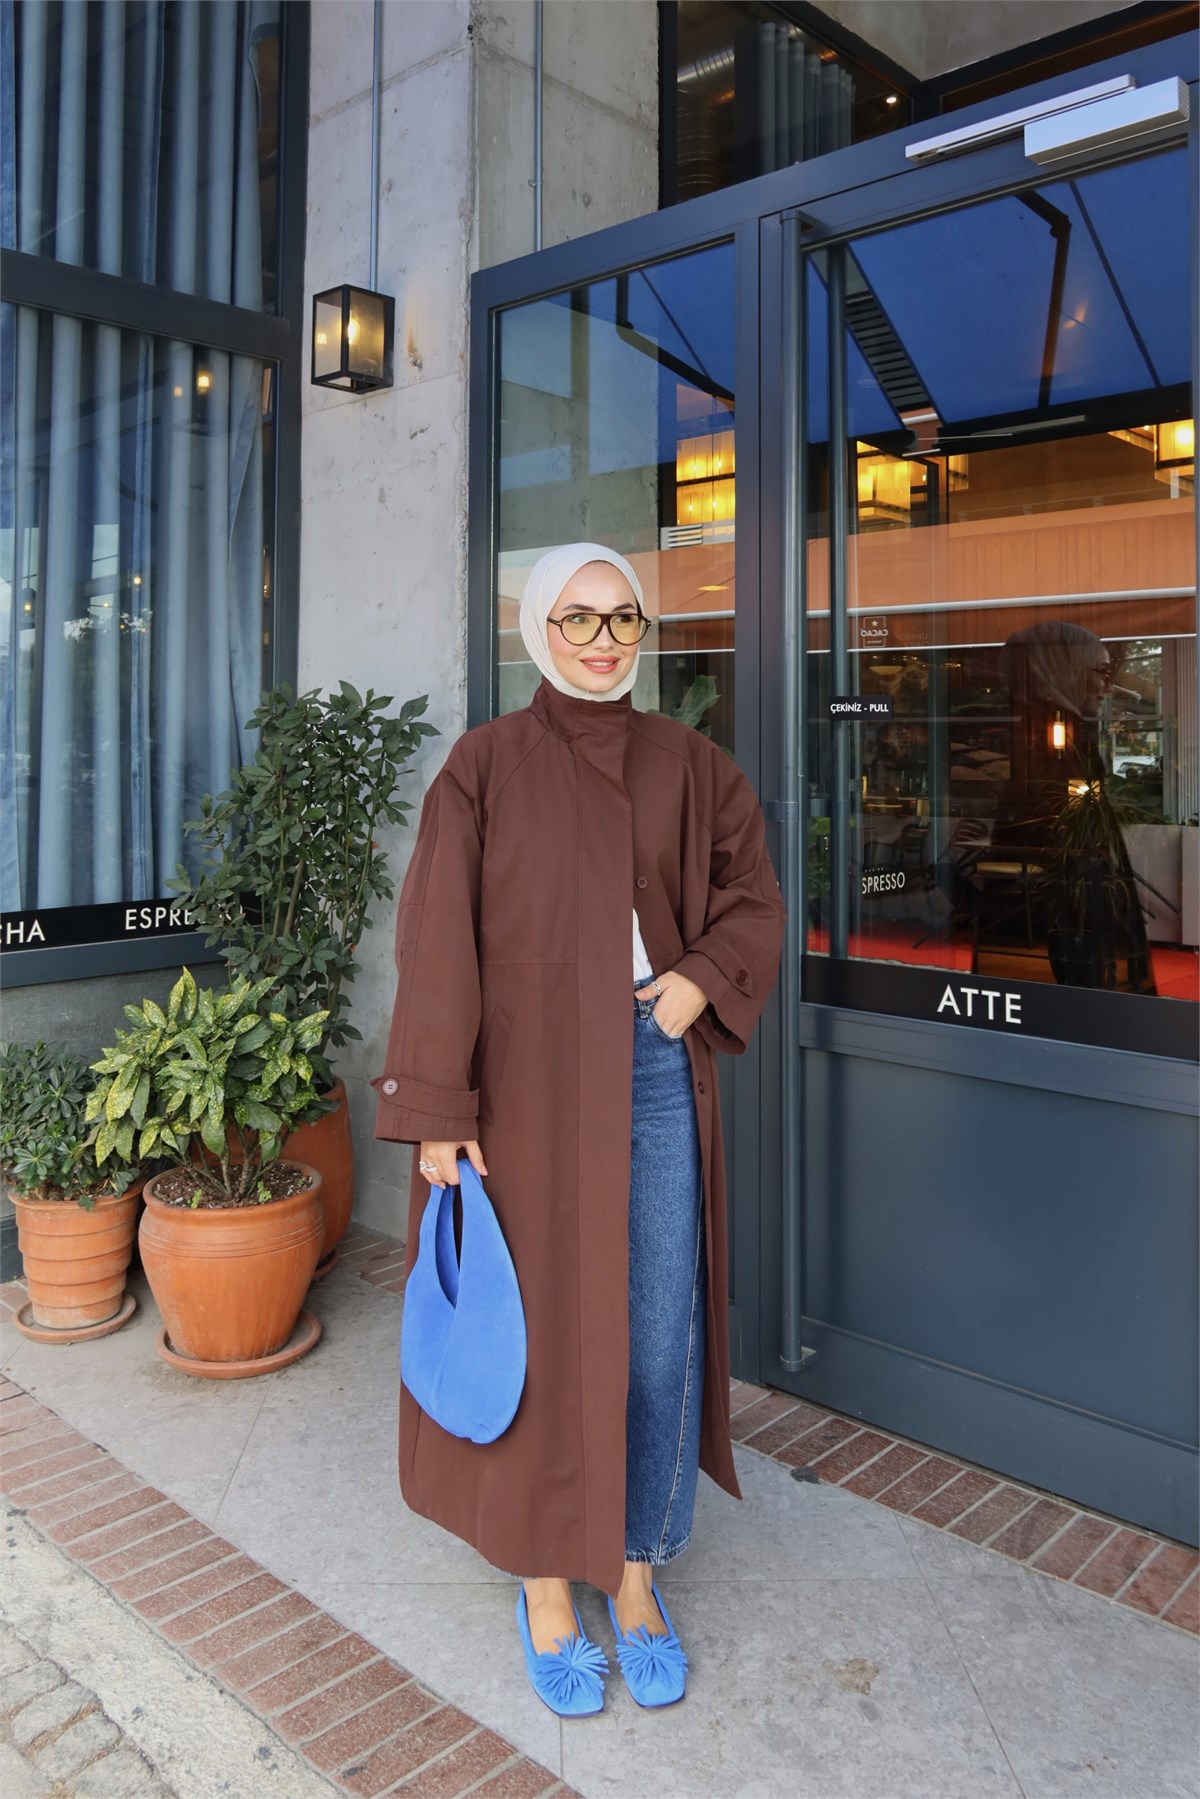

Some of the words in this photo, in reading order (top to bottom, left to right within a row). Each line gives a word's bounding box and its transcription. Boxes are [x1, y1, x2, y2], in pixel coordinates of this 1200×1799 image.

[830, 702, 862, 714] ÇEKİNİZ
[869, 703, 889, 712] PULL
[0, 919, 46, 945] HA
[936, 983, 1022, 1025] ATTE
